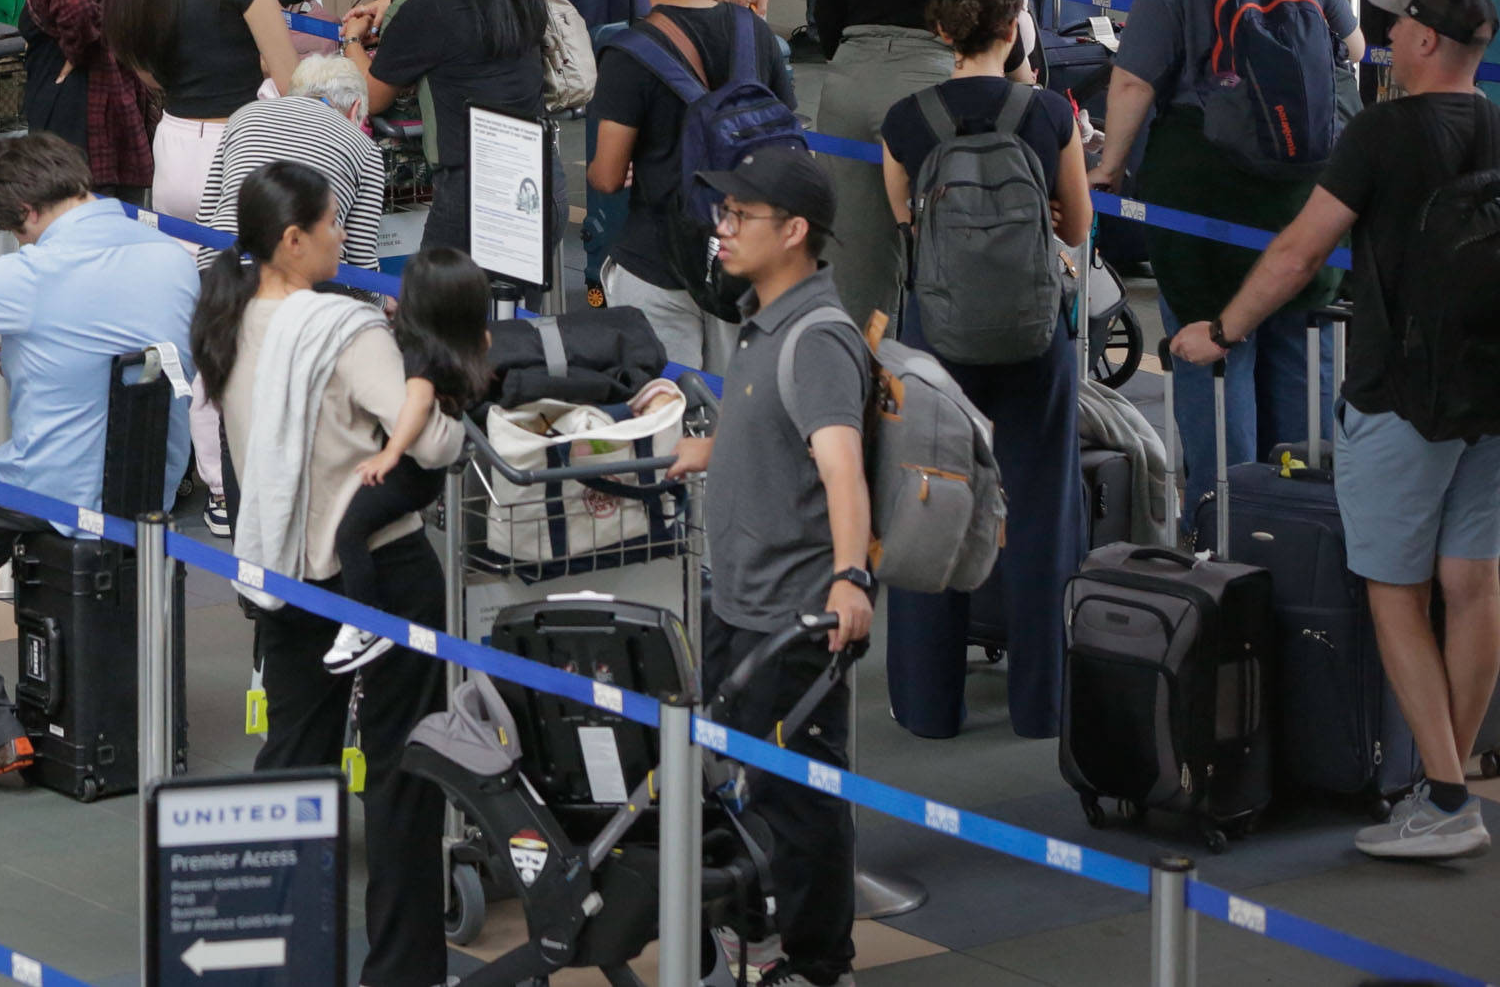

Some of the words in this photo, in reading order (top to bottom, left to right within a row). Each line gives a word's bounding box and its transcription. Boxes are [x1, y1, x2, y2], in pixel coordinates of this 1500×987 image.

[1274, 105, 1297, 157] patagonia
[172, 804, 287, 826] UNITED
[171, 851, 238, 872] Premier
[241, 850, 298, 866] Access
